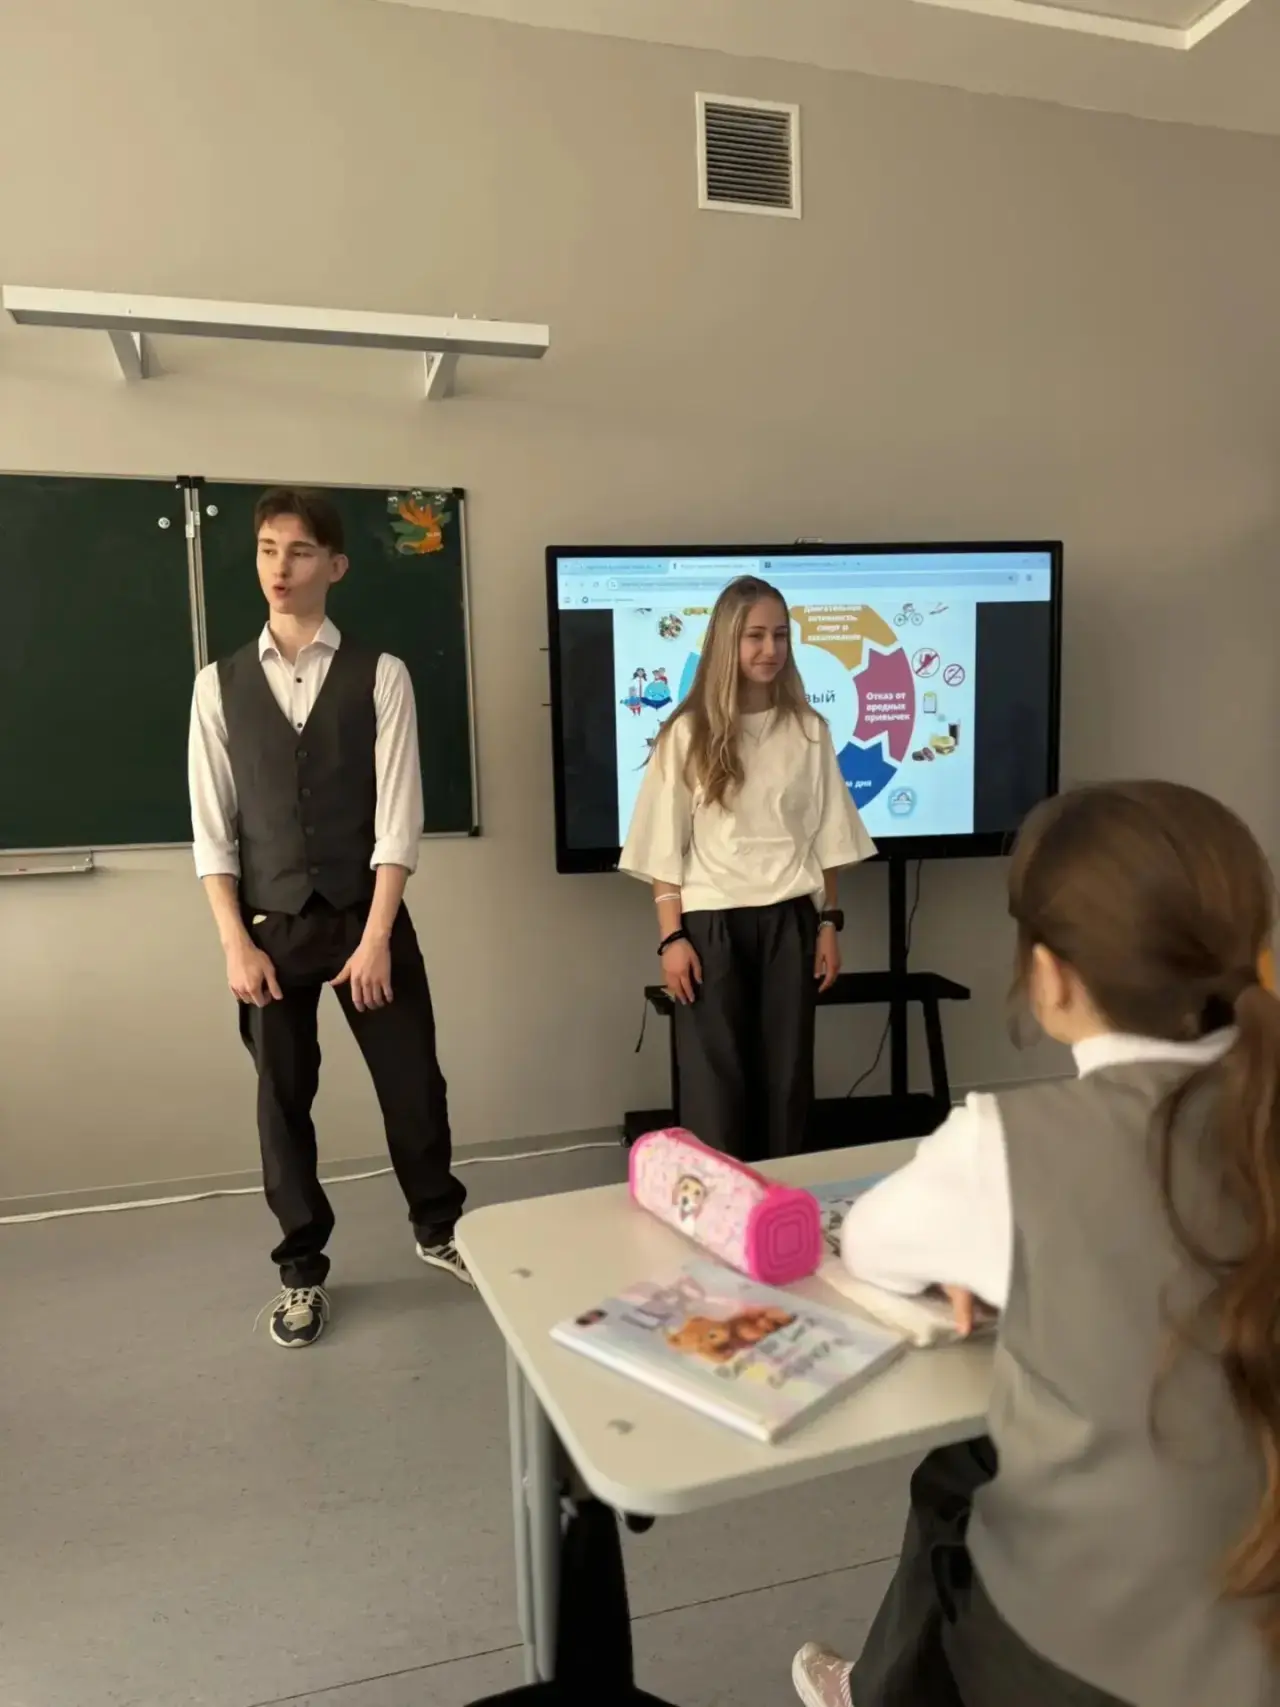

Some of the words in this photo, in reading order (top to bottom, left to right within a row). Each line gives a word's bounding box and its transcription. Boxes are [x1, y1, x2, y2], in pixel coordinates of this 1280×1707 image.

[866, 691, 893, 701] Отказ
[895, 692, 906, 700] от
[866, 703, 905, 713] вредных
[864, 714, 910, 724] привычек
